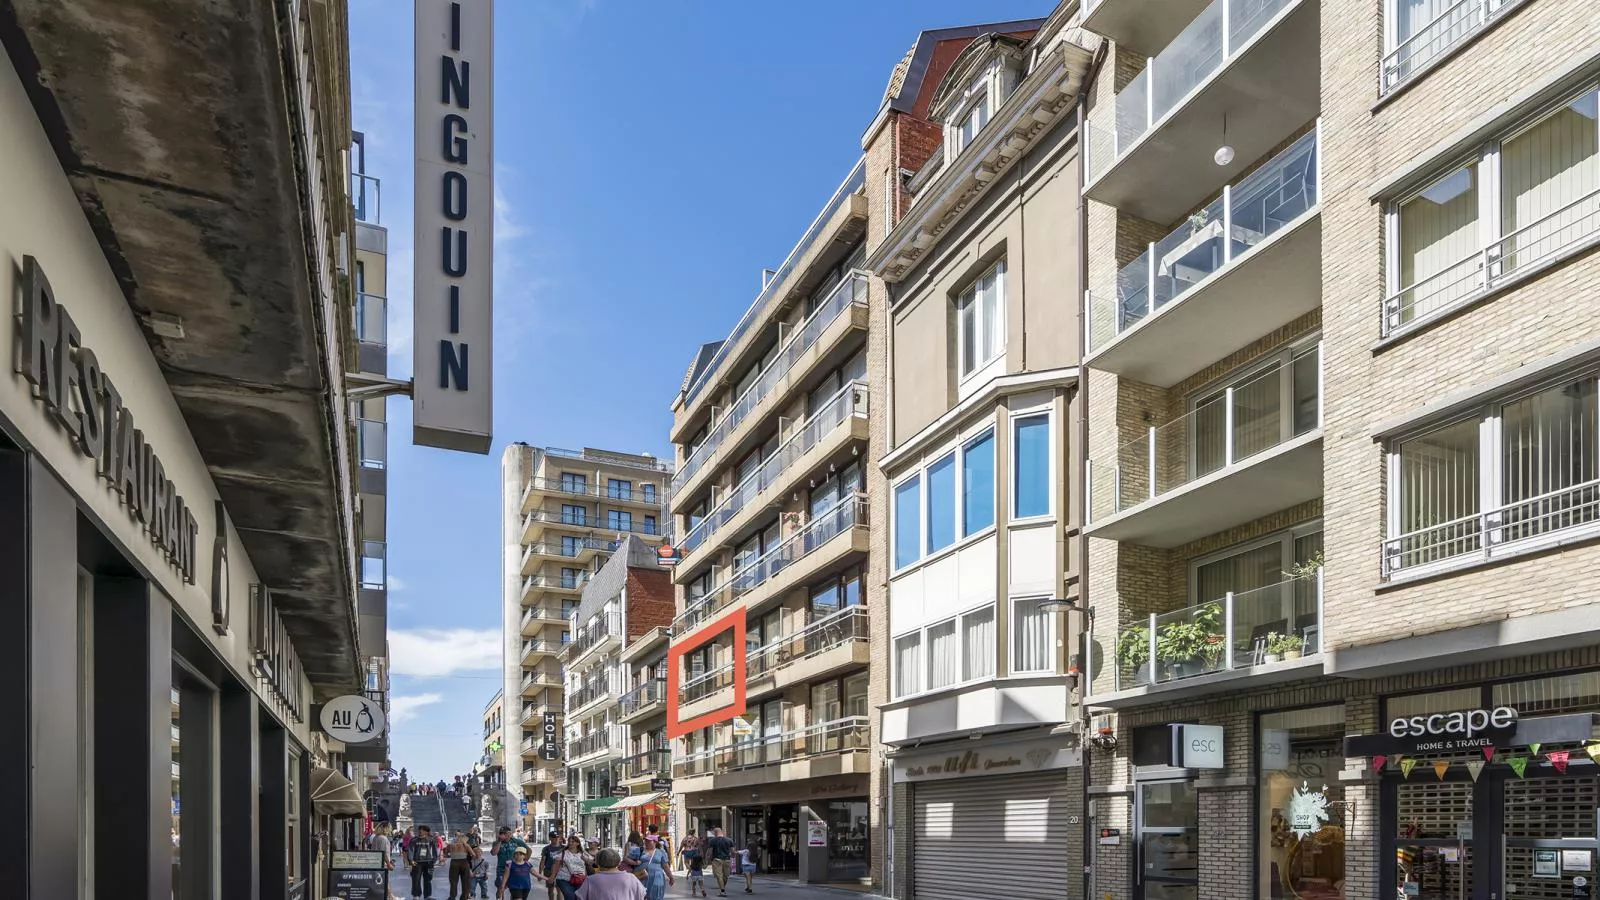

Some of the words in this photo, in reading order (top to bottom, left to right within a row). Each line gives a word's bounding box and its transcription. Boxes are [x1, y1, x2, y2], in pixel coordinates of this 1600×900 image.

[440, 1, 470, 392] INGOUIN
[22, 254, 199, 585] RESTAURANT
[331, 710, 351, 726] AU
[1390, 706, 1514, 738] escape
[544, 714, 555, 760] HOTEL
[1191, 738, 1216, 753] esc
[1416, 741, 1443, 751] HOME
[1456, 738, 1493, 748] TRAVEL
[1069, 815, 1079, 824] 20
